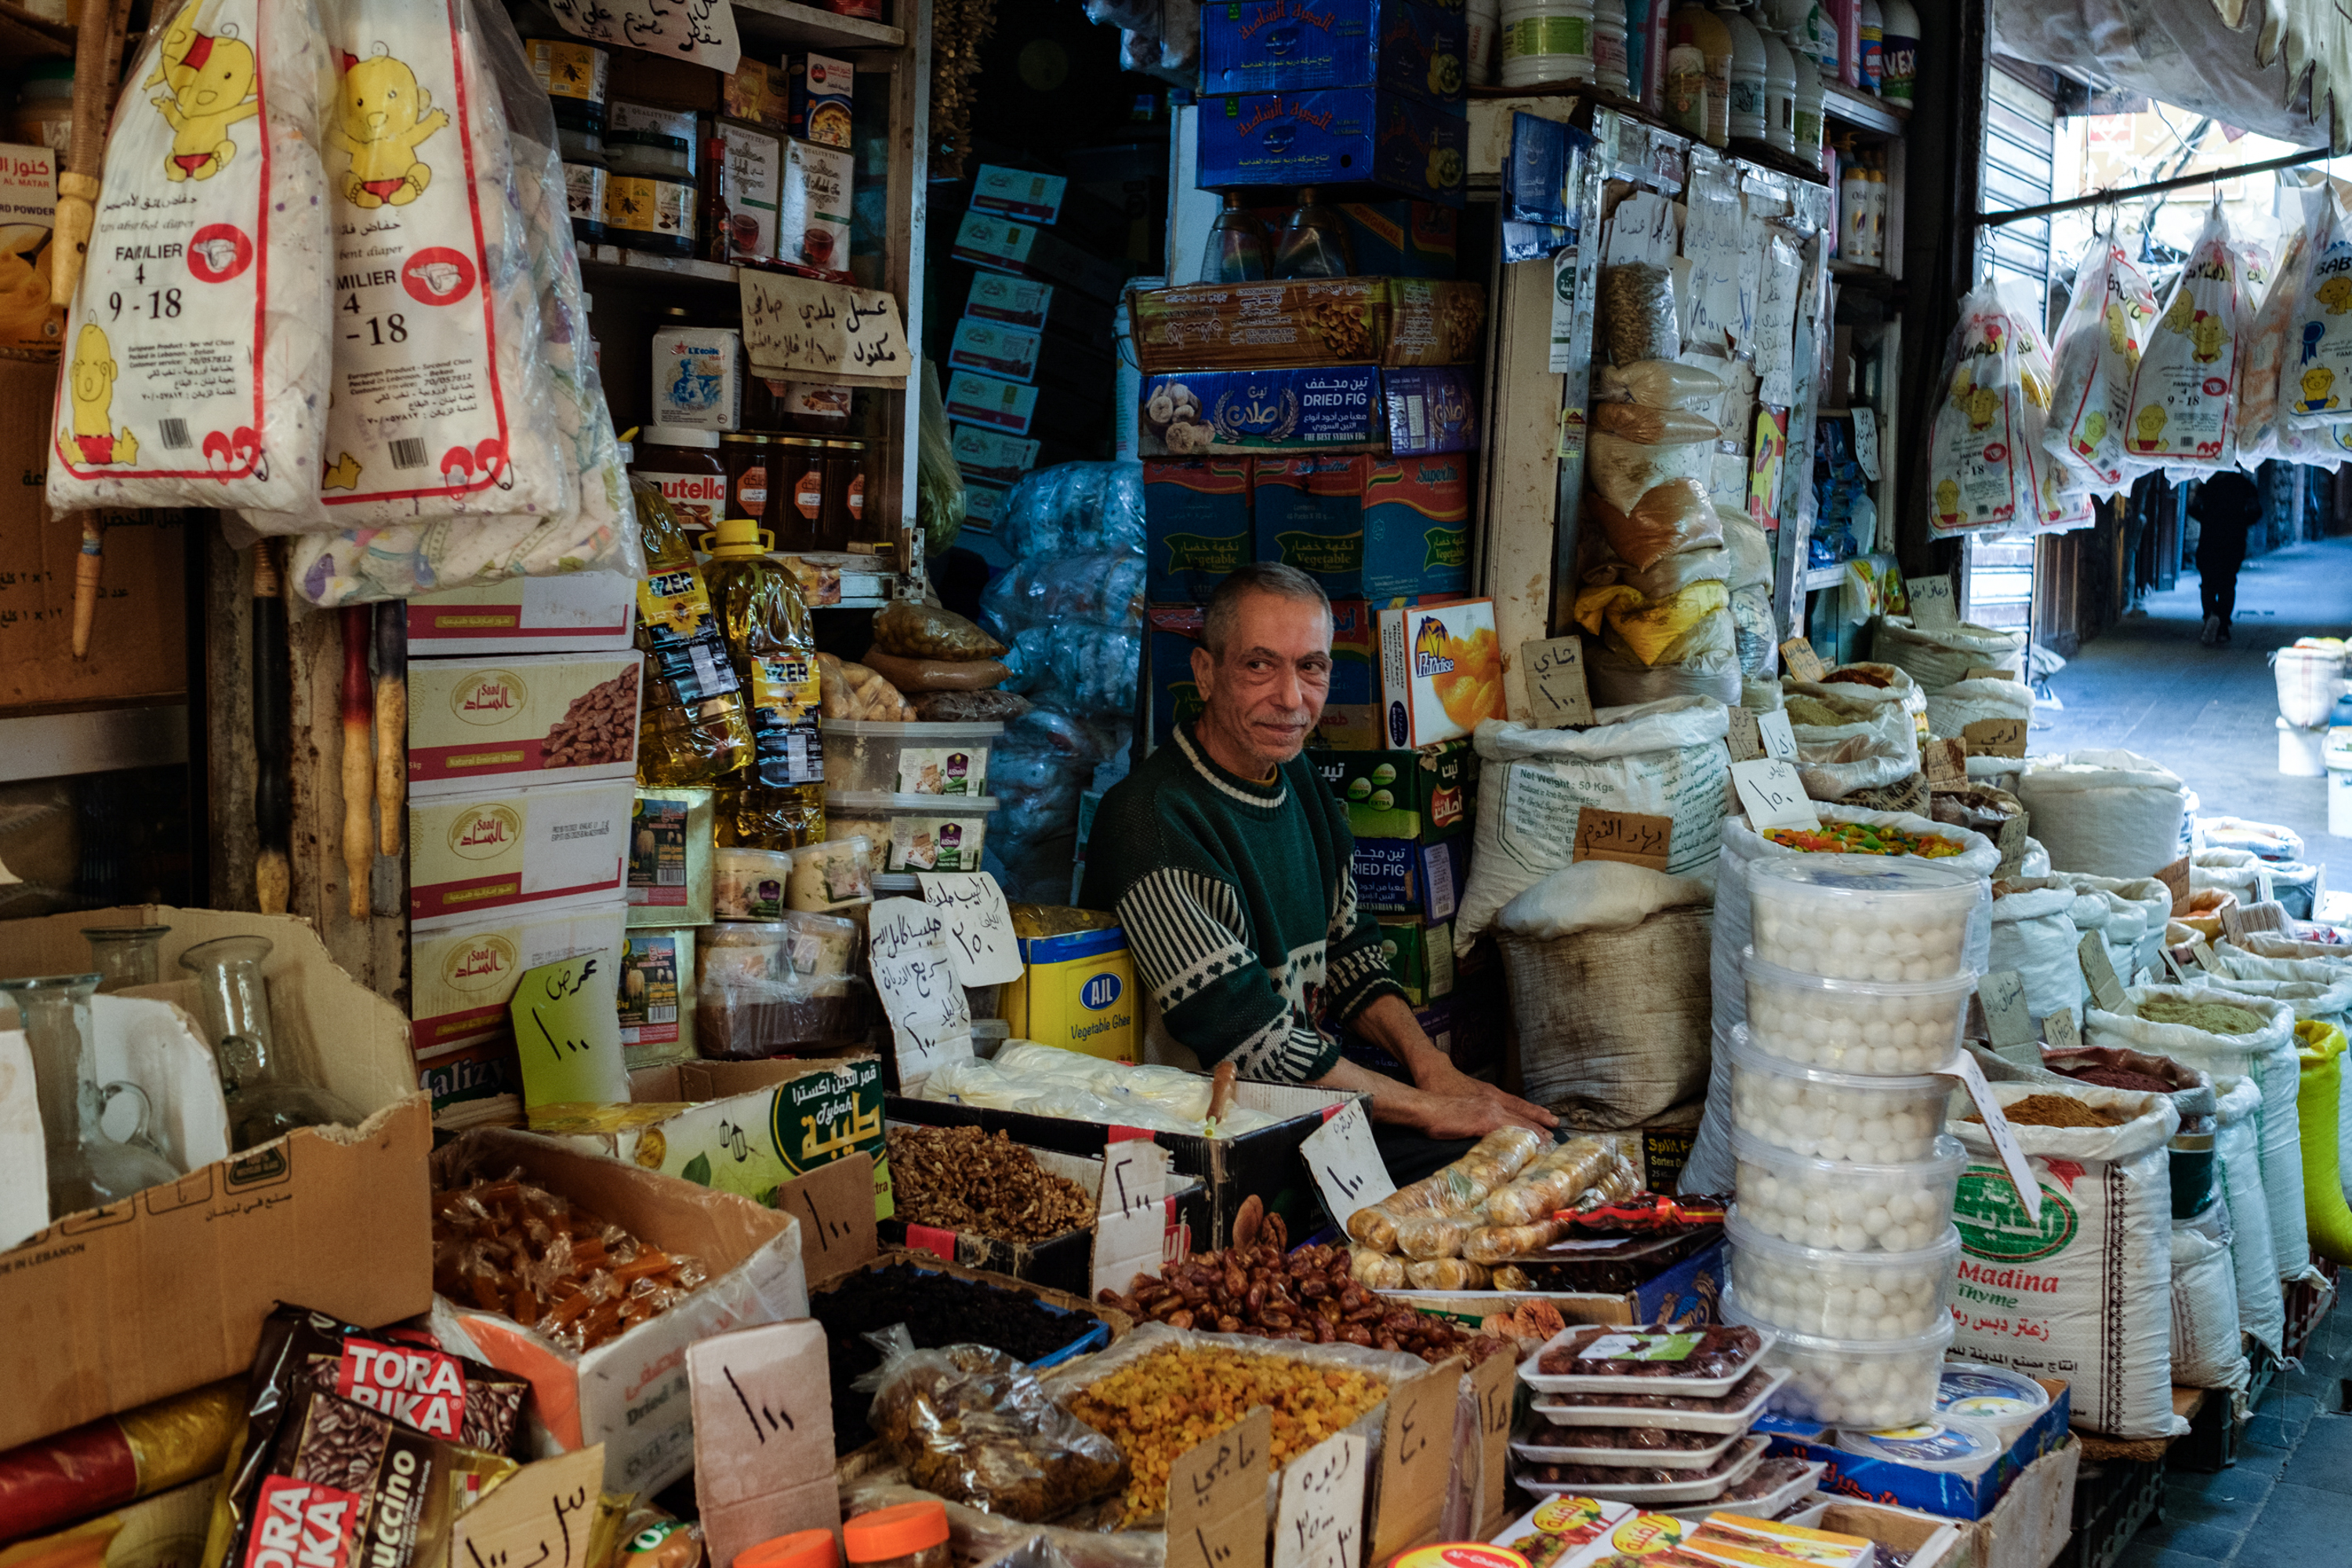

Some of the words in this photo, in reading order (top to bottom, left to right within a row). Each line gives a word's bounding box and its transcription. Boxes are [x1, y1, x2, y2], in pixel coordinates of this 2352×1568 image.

[1470, 26, 1482, 60] CLASSIC
[18, 179, 49, 188] MATAR
[14, 205, 55, 216] POWDER
[367, 245, 404, 258] diaper
[135, 263, 145, 285] 4
[336, 270, 397, 290] MILIER
[108, 291, 122, 322] 9
[147, 288, 182, 319] 18
[343, 292, 361, 314] 4
[799, 294, 835, 328] بلدي
[847, 295, 887, 332] عسل
[366, 313, 408, 347] 18
[385, 366, 416, 376] Product
[1305, 378, 1348, 390] مجفف
[1349, 377, 1368, 390] تين
[1303, 393, 1341, 407] DRIED
[1345, 393, 1367, 405] FIG
[2168, 396, 2175, 406] 9
[2187, 396, 2200, 407] 18
[1316, 433, 1331, 441] BEST
[1353, 432, 1366, 441] FIG
[1972, 465, 1984, 476] 18
[1296, 553, 1352, 566] Vegetable
[1534, 648, 1576, 680] شاي
[481, 683, 499, 696] Saad
[1521, 769, 1534, 781] Net
[1537, 774, 1570, 789] Weight
[1579, 782, 1590, 791] 50
[1594, 782, 1614, 793] Kgs
[1518, 797, 1525, 805] By
[477, 818, 495, 832] Saad
[1387, 848, 1406, 862] تين
[1383, 864, 1405, 877] FIG
[1371, 902, 1393, 911] SYRIAN
[1394, 903, 1406, 912] FIG
[471, 948, 489, 964] Saad
[1091, 978, 1113, 1006] AJL
[1071, 1018, 1110, 1041] Vegetable
[1112, 1014, 1131, 1030] Ghee
[859, 1065, 878, 1087] قمر
[792, 1079, 830, 1106] اكسترا
[801, 1091, 881, 1160] طيبة
[1648, 1138, 1680, 1154] Split
[1650, 1156, 1675, 1167] Sortex
[244, 1197, 263, 1215] في
[265, 1193, 292, 1209] صنع
[205, 1203, 241, 1221] لبنان
[15, 1258, 27, 1270] IN
[28, 1243, 85, 1267] LEBANON
[1957, 1261, 2060, 1294] Madina
[1958, 1285, 2018, 1309] Thyme
[1973, 1312, 2009, 1332] دبس
[2011, 1318, 2049, 1342] زعتر
[1969, 1350, 2008, 1367] المدينة
[2011, 1359, 2044, 1372] مصنع
[349, 1345, 462, 1397] TORA
[2048, 1361, 2078, 1374] إنتاج
